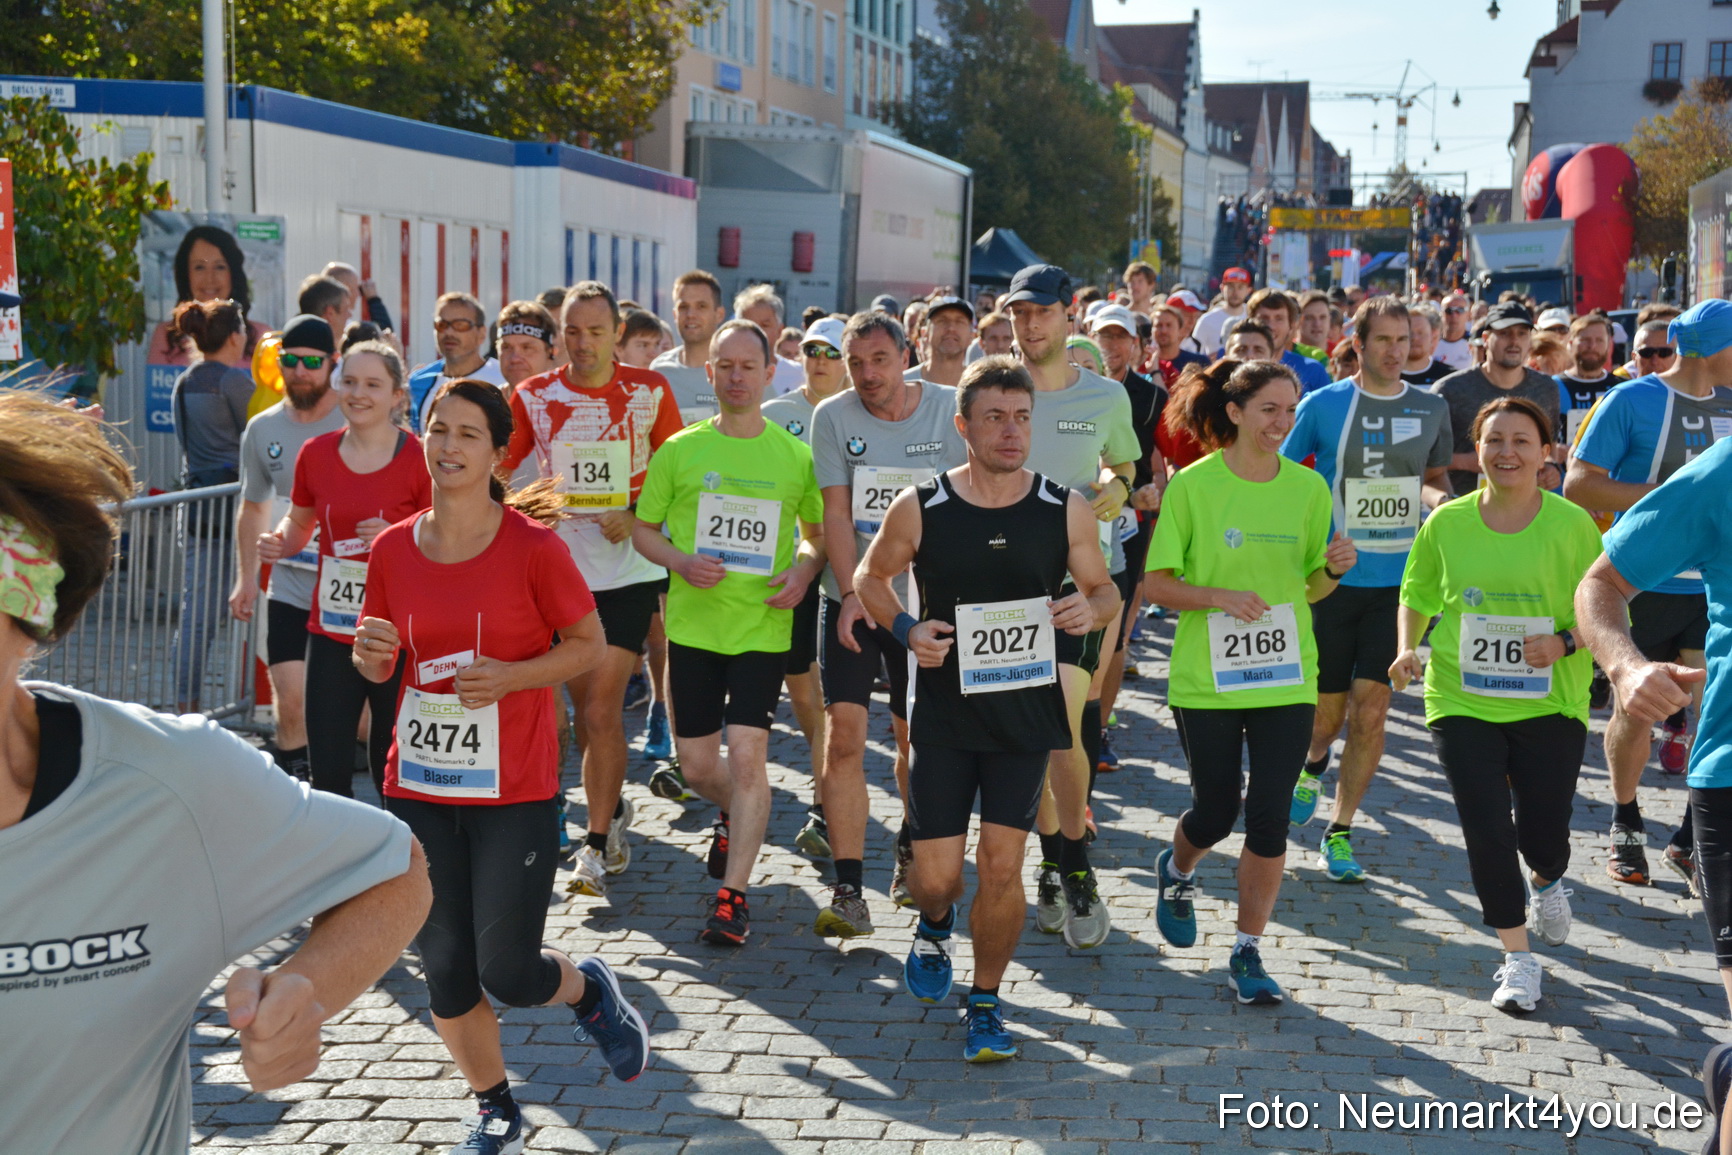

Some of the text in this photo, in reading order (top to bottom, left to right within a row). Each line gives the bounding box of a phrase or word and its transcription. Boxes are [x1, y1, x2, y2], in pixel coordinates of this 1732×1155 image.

[498, 323, 542, 338] didas
[1057, 420, 1096, 432] BOCK
[571, 462, 611, 483] 134
[877, 473, 912, 482] BOCK
[570, 496, 612, 505] Bernhard
[1357, 497, 1409, 518] 2009
[709, 515, 766, 542] 2169
[1369, 530, 1397, 539] Martin
[719, 552, 750, 565] Rainer
[984, 608, 1026, 621] BOCK
[1487, 622, 1526, 633] BOCK
[972, 624, 1039, 655] 2027
[1224, 629, 1286, 658] 2168
[1473, 638, 1523, 664] 216
[433, 660, 458, 674] DEHN
[973, 666, 1043, 682] Hans-Jürgen
[1243, 669, 1273, 681] Maria
[1485, 677, 1524, 689] Larissa
[420, 701, 465, 715] BOCK
[408, 719, 481, 753] 2474
[415, 753, 466, 765] PARTL Neumarkt
[424, 769, 463, 785] Blaser
[0, 923, 150, 979] BOCK
[44, 976, 59, 988] by
[63, 970, 100, 985] smart
[103, 958, 152, 978] concepts
